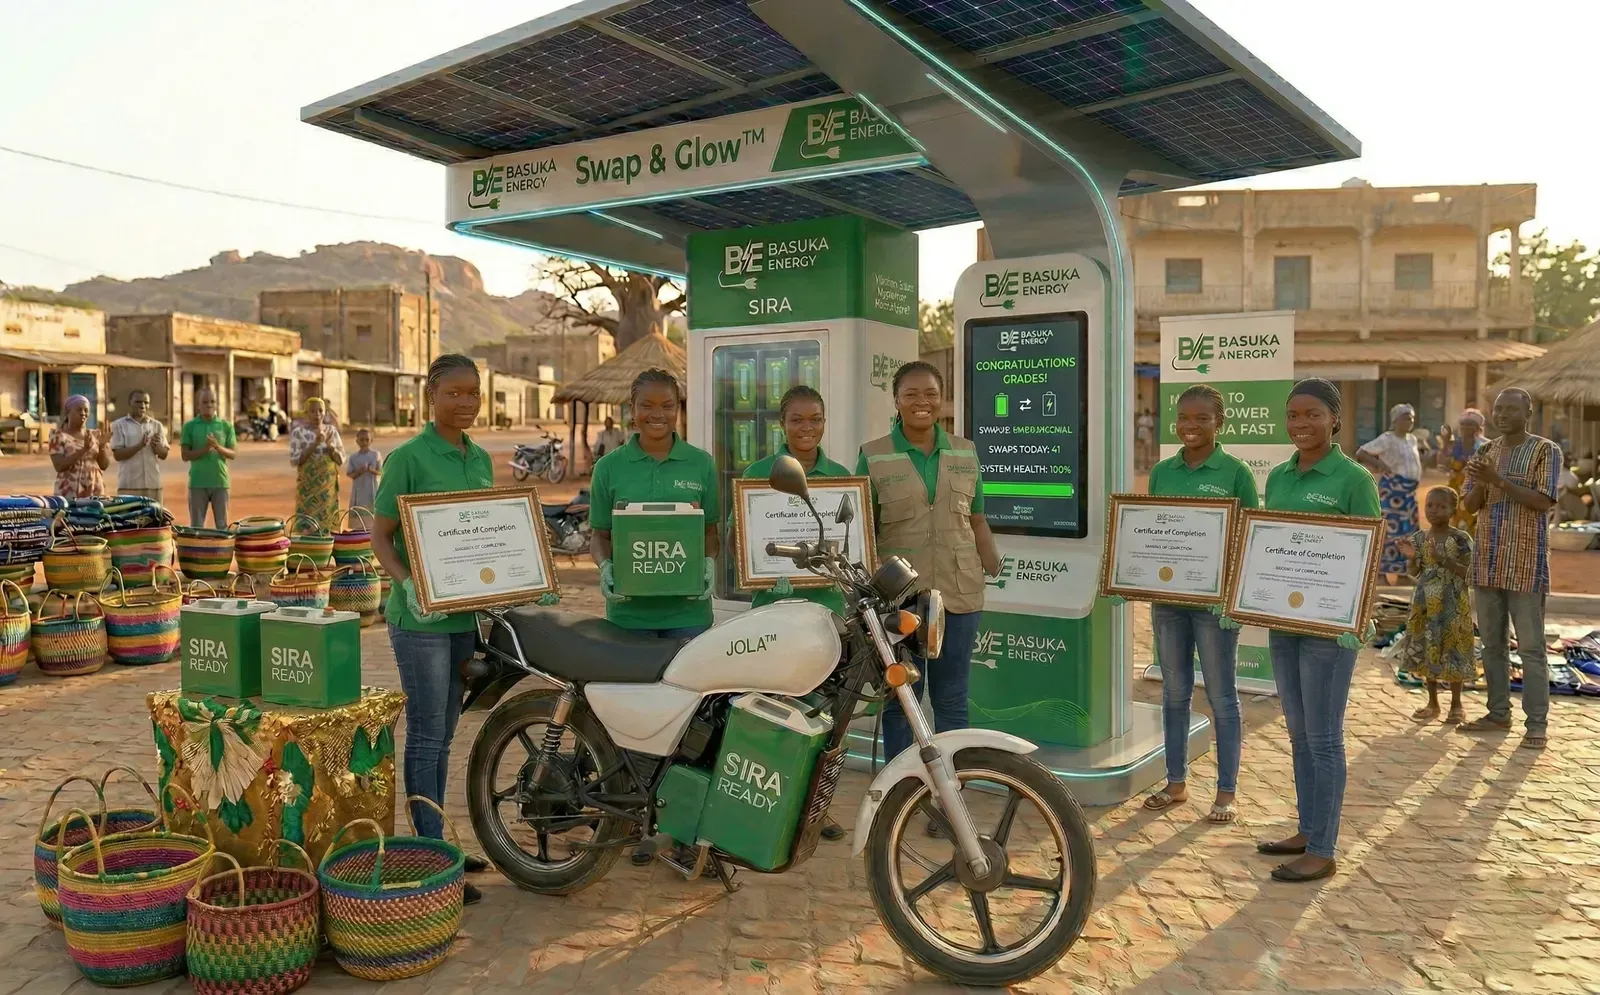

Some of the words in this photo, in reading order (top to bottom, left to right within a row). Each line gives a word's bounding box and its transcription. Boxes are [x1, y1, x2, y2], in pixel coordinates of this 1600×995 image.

[506, 158, 557, 179] BASUKA
[576, 154, 642, 185] Swap
[649, 143, 667, 175] &
[506, 177, 548, 193] ENERGY
[768, 237, 829, 256] BASUKA
[768, 255, 817, 271] ENERGY
[1022, 268, 1081, 283] BASUKA
[1022, 283, 1069, 296] ENERGY
[748, 296, 793, 316] SIRA
[1020, 329, 1054, 339] BASUKA
[1218, 334, 1280, 348] BASUKA
[1020, 337, 1049, 346] ENERGY
[1218, 349, 1278, 360] ANERGRY
[976, 357, 1076, 371] CONGRATULATIONS
[1003, 373, 1048, 384] GRADES!
[1228, 392, 1245, 403] TO
[1240, 423, 1276, 435] FAST
[988, 445, 1018, 454] SWAPS
[1019, 445, 1050, 454] TODAY:
[1051, 445, 1061, 454] 41
[980, 464, 1011, 473] SYSTEM
[1013, 464, 1048, 474] HEALTH:
[1049, 465, 1072, 474] 100%
[480, 524, 517, 533] Completion
[1133, 527, 1163, 535] Certificate
[632, 541, 687, 559] SIRA
[1265, 546, 1298, 557] Certificate
[1307, 550, 1346, 561] Completion
[632, 562, 686, 574] READY
[1017, 560, 1069, 573] BASUKA
[1016, 571, 1057, 582] ENERGY
[189, 638, 228, 660] SIRA
[1007, 634, 1067, 652] BASUKA
[271, 647, 314, 670] SIRA
[1008, 649, 1055, 663] ENERGY
[190, 657, 229, 674] READY
[271, 667, 314, 685] READY
[723, 752, 782, 797] SIRA
[717, 777, 778, 813] READY
